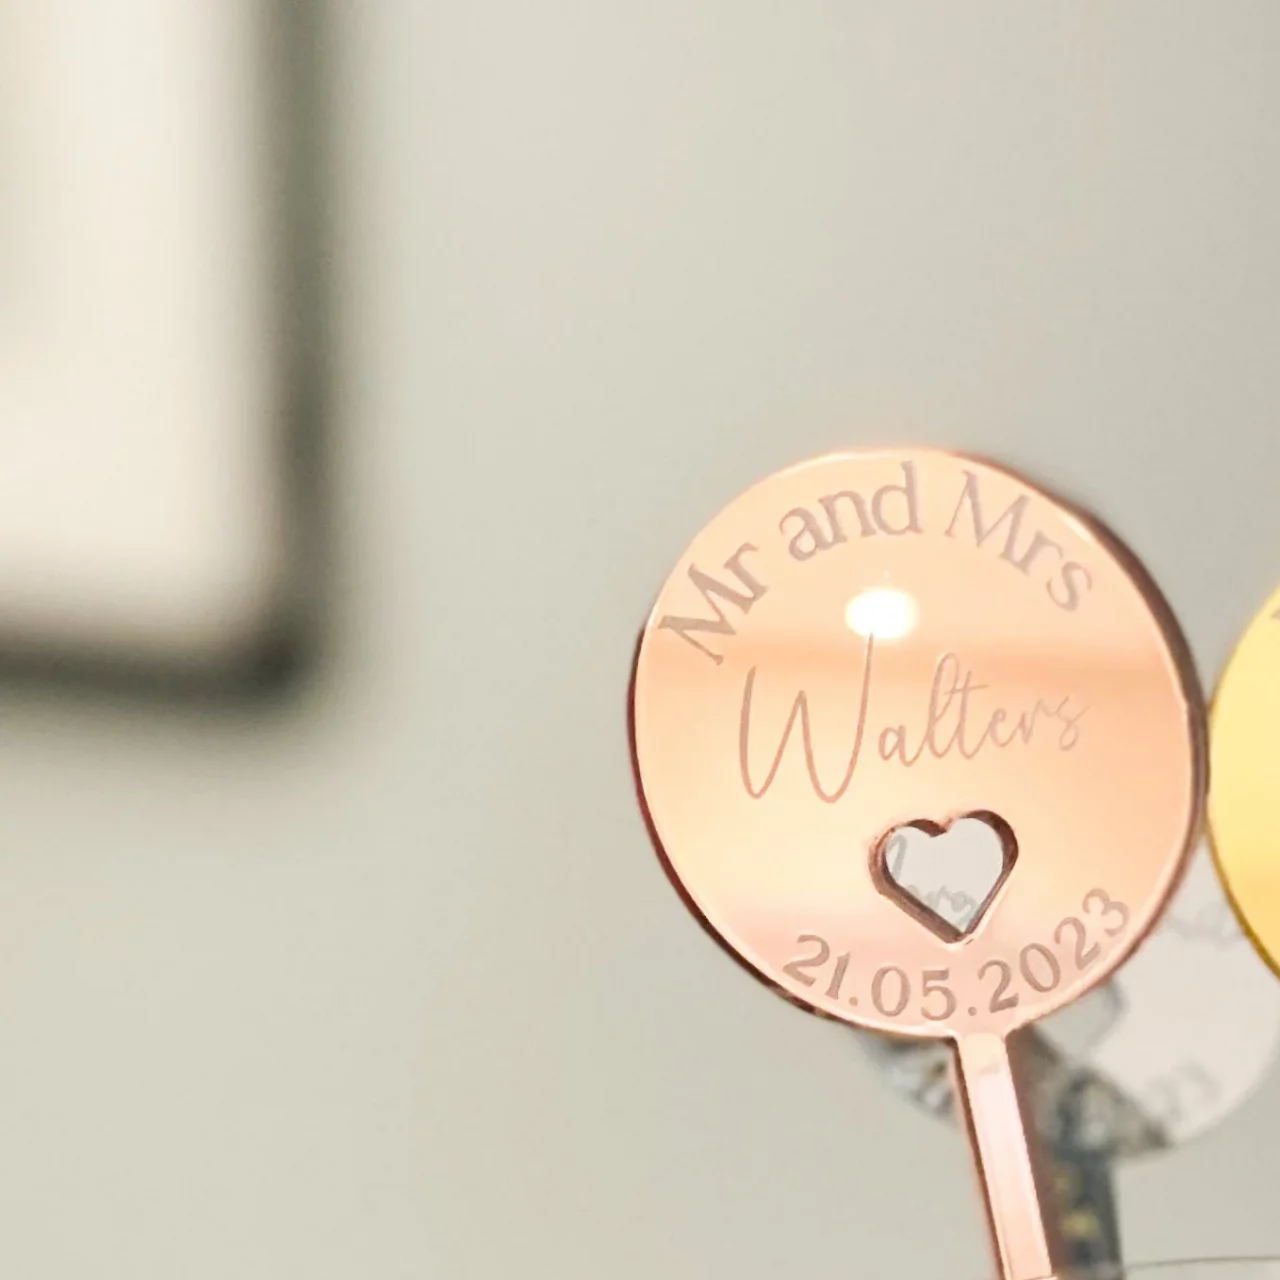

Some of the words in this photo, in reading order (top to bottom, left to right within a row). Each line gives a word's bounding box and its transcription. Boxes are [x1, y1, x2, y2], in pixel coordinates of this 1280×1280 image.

[657, 541, 769, 666] Mr
[779, 461, 924, 562] and
[944, 469, 1093, 613] Mrs
[739, 632, 1093, 804] Walters
[782, 887, 1131, 1022] 21.05.2023
